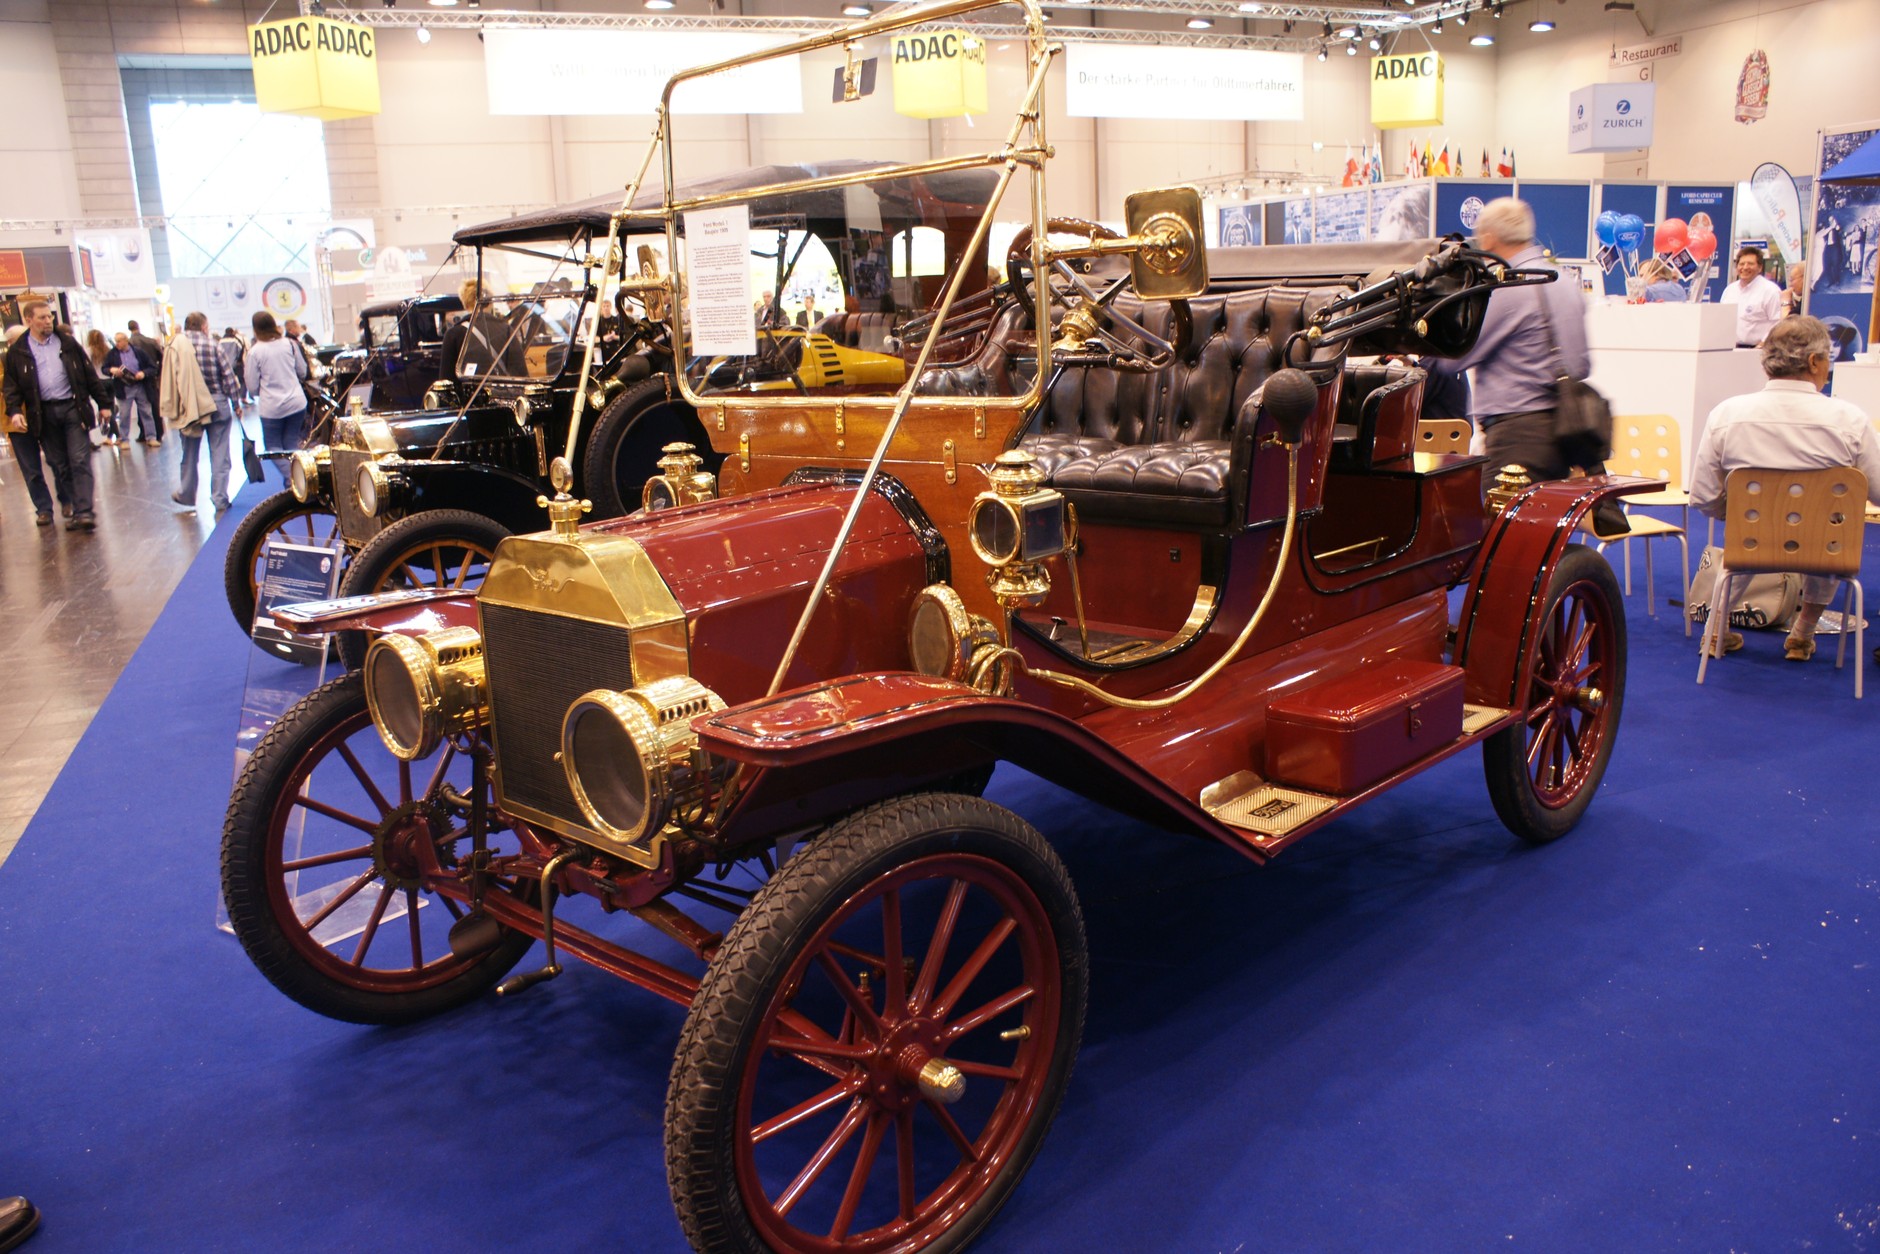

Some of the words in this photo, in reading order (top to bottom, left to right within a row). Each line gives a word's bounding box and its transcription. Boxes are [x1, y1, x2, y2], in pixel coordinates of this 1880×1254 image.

[254, 22, 310, 57] ADAC
[317, 23, 372, 58] ADAC
[895, 34, 957, 64] ADAC
[1621, 42, 1678, 62] Restaurant
[1375, 56, 1433, 80] ADAC
[1079, 71, 1098, 85] Der
[1104, 73, 1141, 86] starke
[1603, 119, 1643, 129] ZURICH
[1622, 232, 1638, 240] Ford
[1254, 800, 1292, 819] Ford
